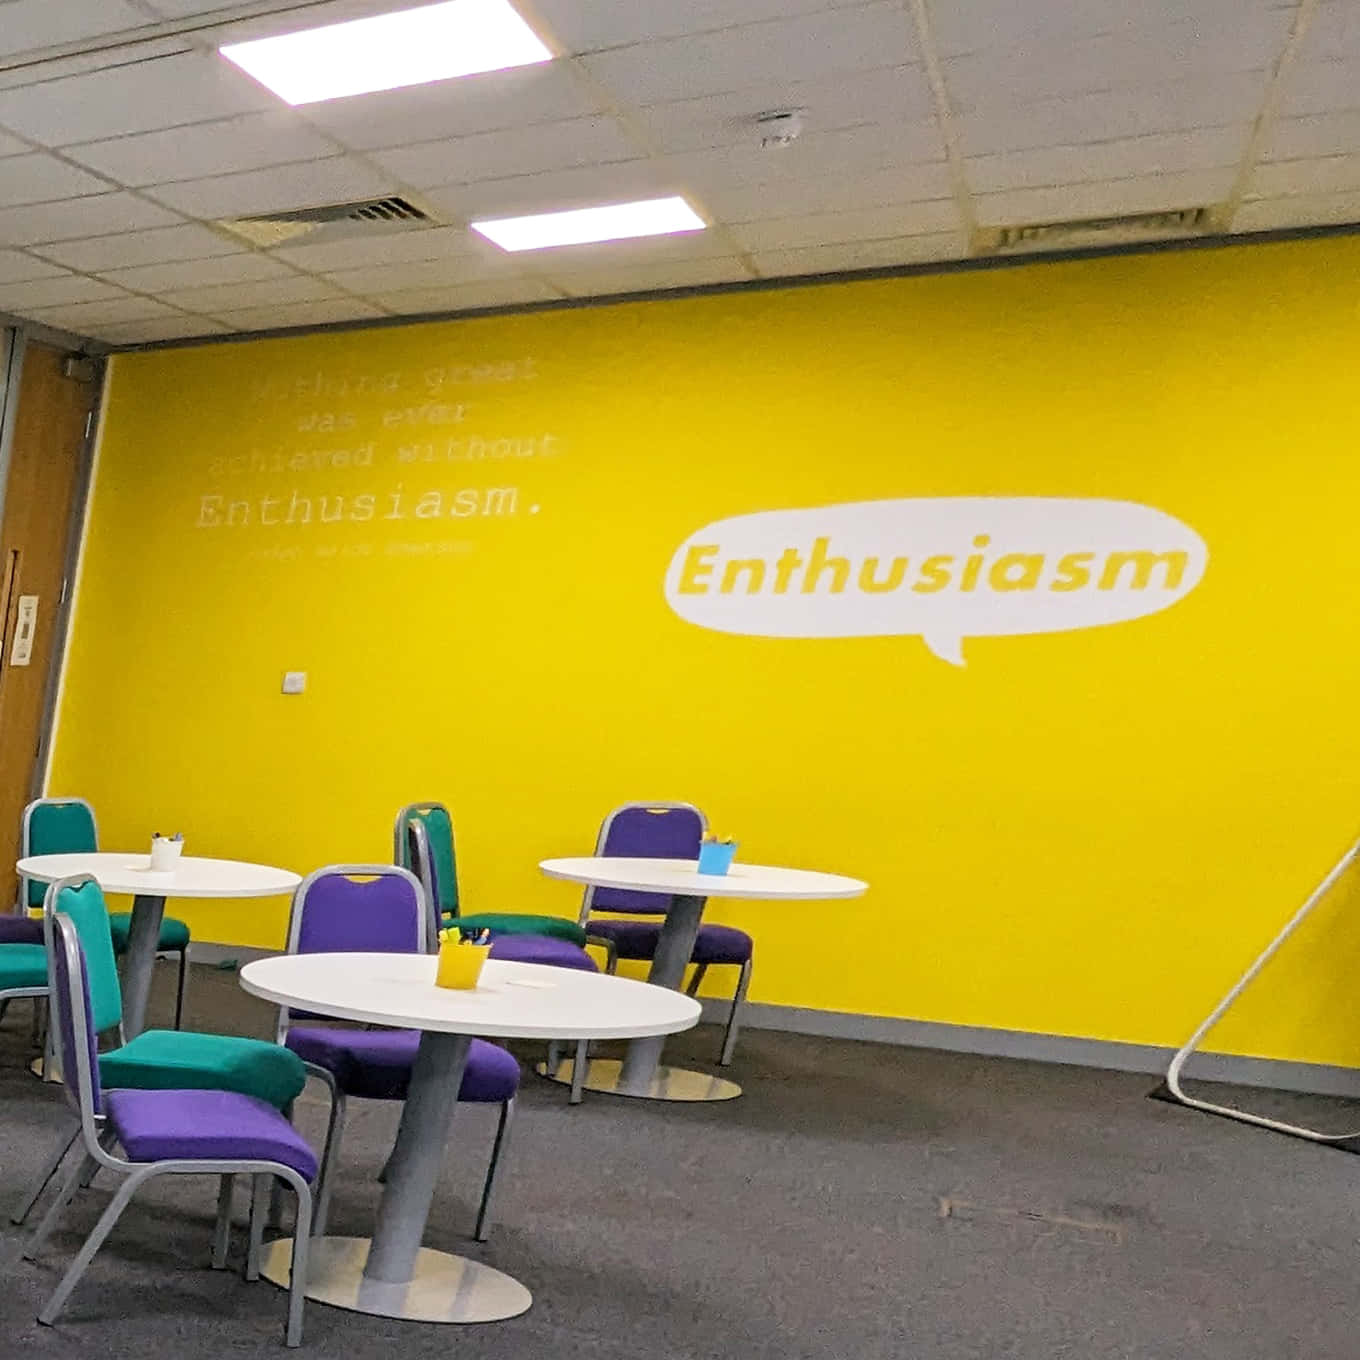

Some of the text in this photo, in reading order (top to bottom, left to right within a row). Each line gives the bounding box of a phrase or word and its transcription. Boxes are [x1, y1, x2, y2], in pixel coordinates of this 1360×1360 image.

[423, 356, 542, 395] great
[294, 401, 473, 434] was ever
[395, 431, 562, 465] without
[194, 482, 544, 529] Enthusiasm.
[676, 534, 1189, 596] Enthusiasm
